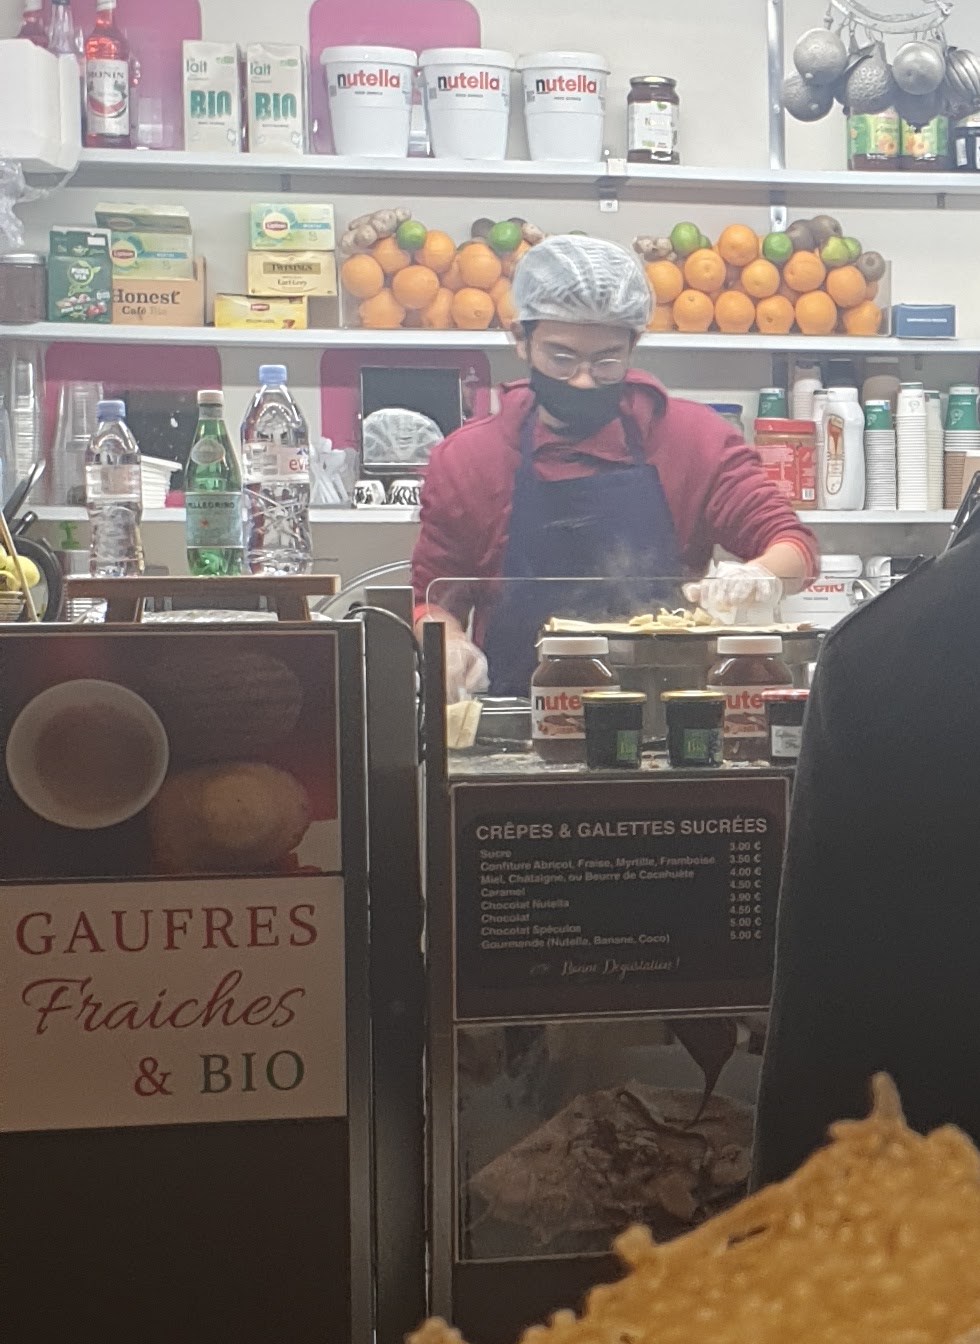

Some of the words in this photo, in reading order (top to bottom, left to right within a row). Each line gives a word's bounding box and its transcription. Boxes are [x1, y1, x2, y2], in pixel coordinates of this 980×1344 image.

[186, 58, 207, 73] lait
[250, 61, 271, 76] lait
[337, 69, 400, 88] nutella
[438, 71, 500, 91] nutella
[536, 74, 597, 94] nutella
[190, 90, 232, 119] BIO
[255, 92, 297, 121] BIO
[271, 263, 313, 272] TWININGS
[112, 288, 181, 305] Honest
[535, 691, 582, 711] nute
[476, 821, 554, 840] CRÊPES
[558, 823, 572, 839] &
[577, 820, 676, 838] GALETTES
[680, 815, 768, 834] SUCRÉES
[16, 904, 318, 955] GAUFRES
[21, 970, 306, 1035] Fraiches
[134, 1057, 173, 1097] &
[200, 1050, 305, 1094] BIO
